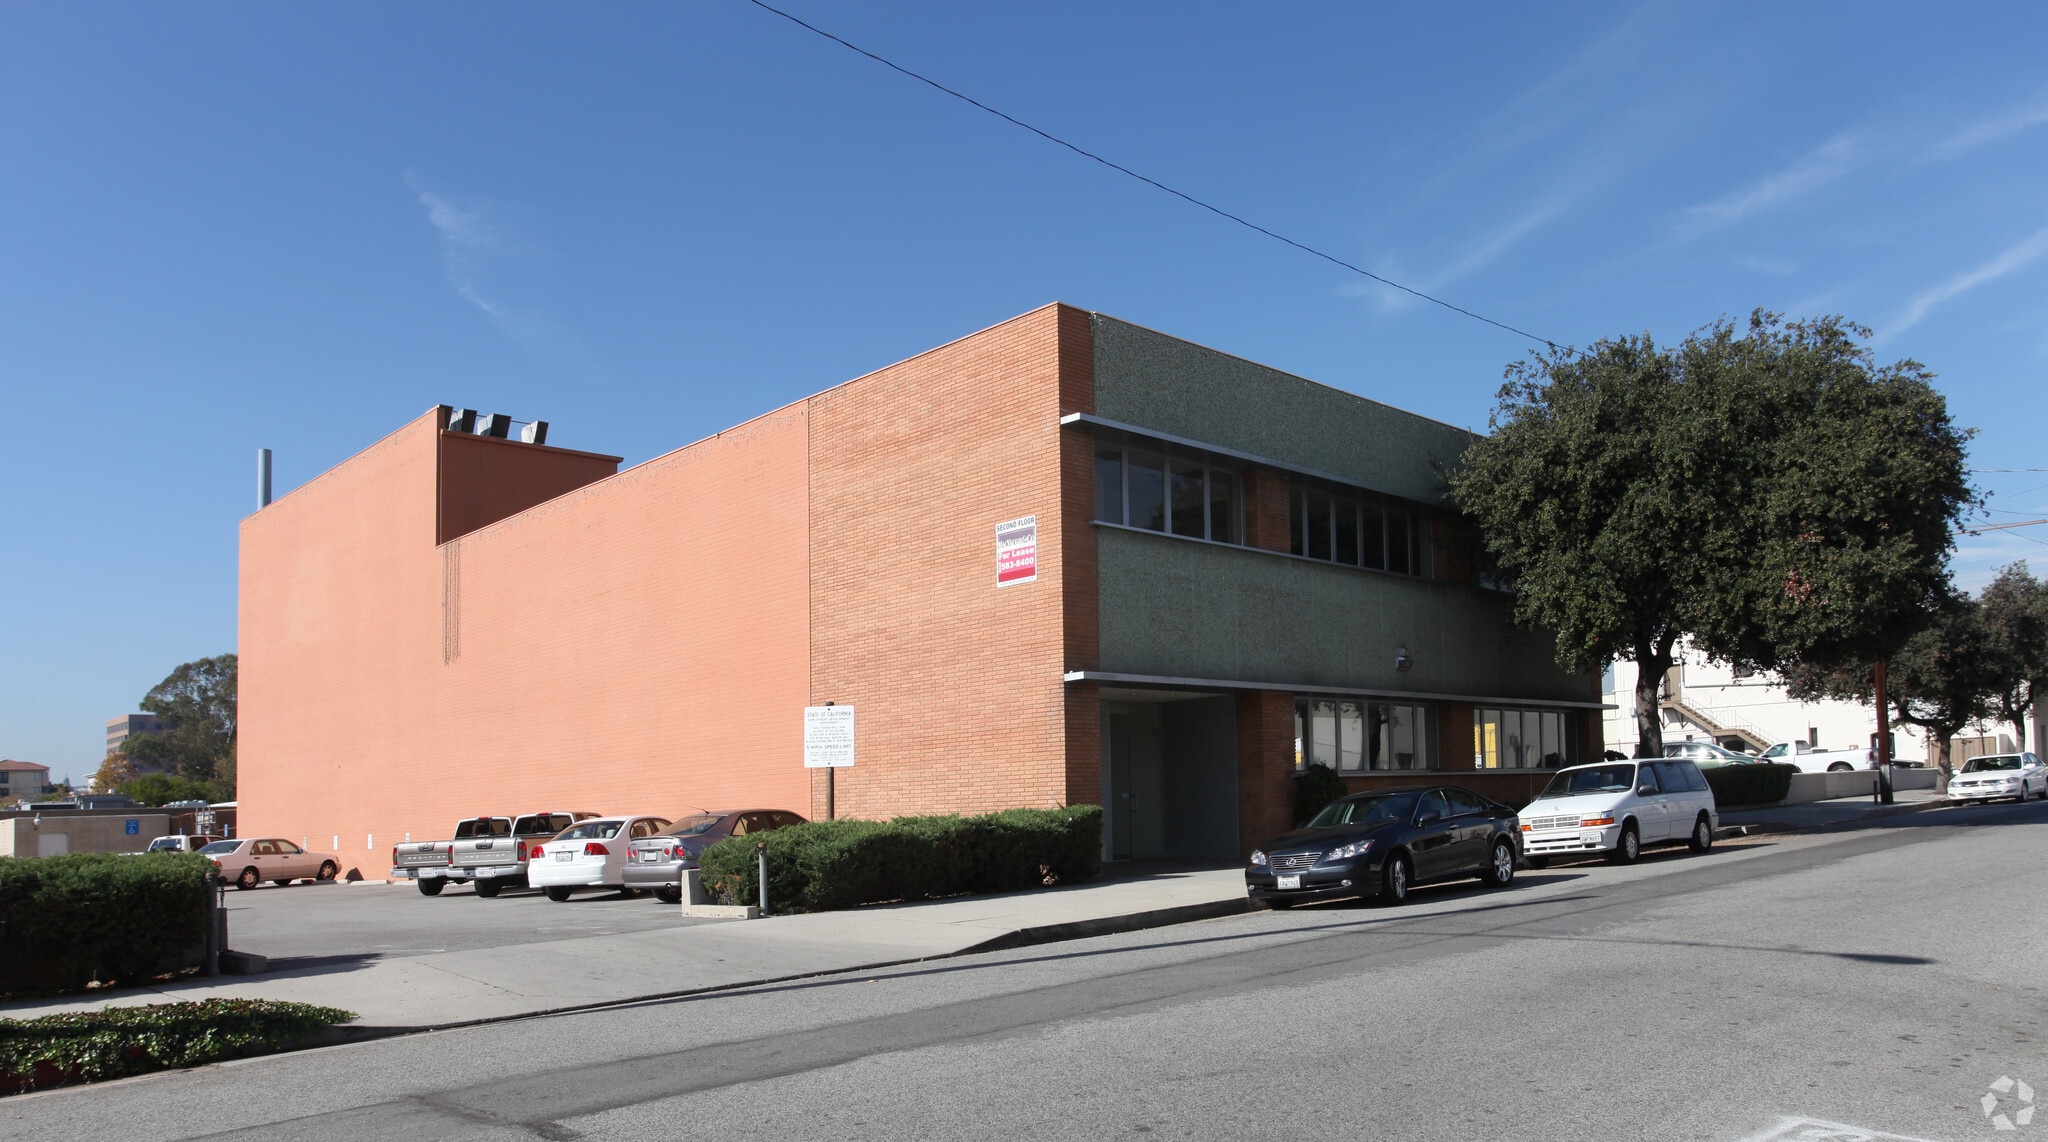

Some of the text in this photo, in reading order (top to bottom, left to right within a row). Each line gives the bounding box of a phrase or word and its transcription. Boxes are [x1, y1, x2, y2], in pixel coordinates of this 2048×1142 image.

[996, 516, 1034, 532] SECOND FLOOR
[998, 547, 1034, 560] For Lease
[1002, 556, 1034, 570] 583-8400
